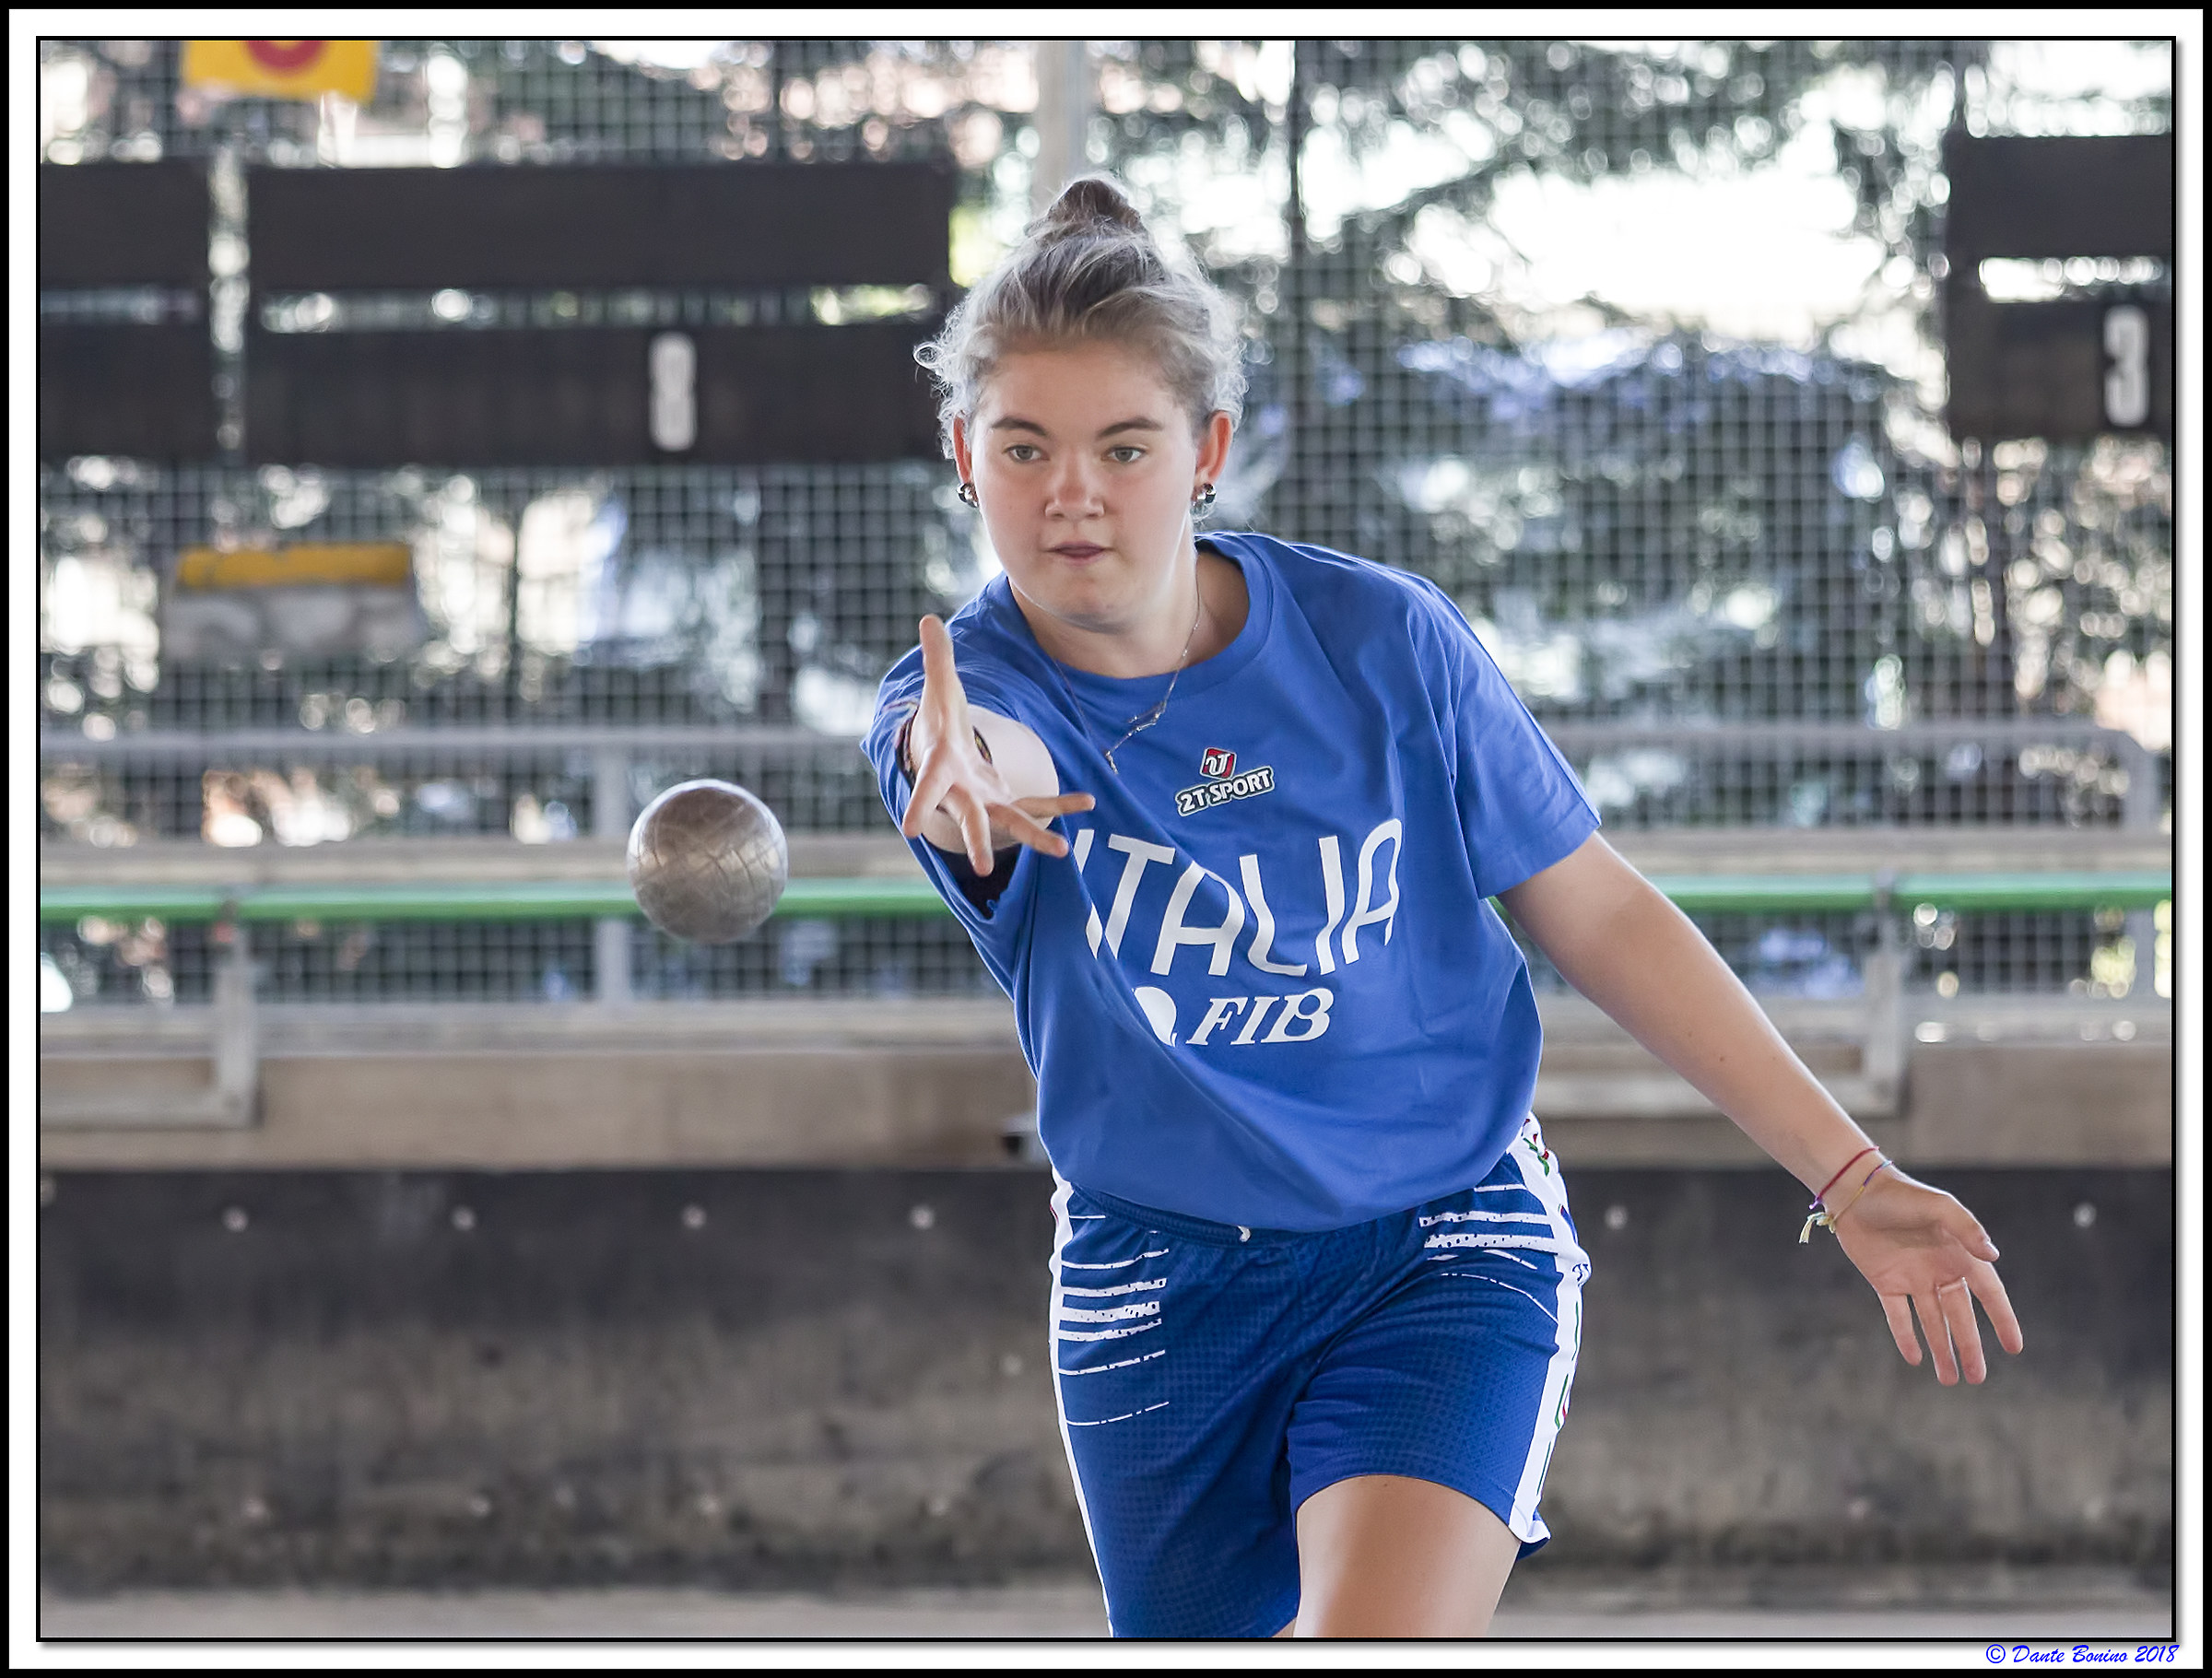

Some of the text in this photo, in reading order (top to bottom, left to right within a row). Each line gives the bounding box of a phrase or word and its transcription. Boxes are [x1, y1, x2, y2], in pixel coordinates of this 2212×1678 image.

[2103, 304, 2150, 427] 3
[1180, 769, 1270, 813] 2T SPORT
[1185, 988, 1335, 1046] FIB
